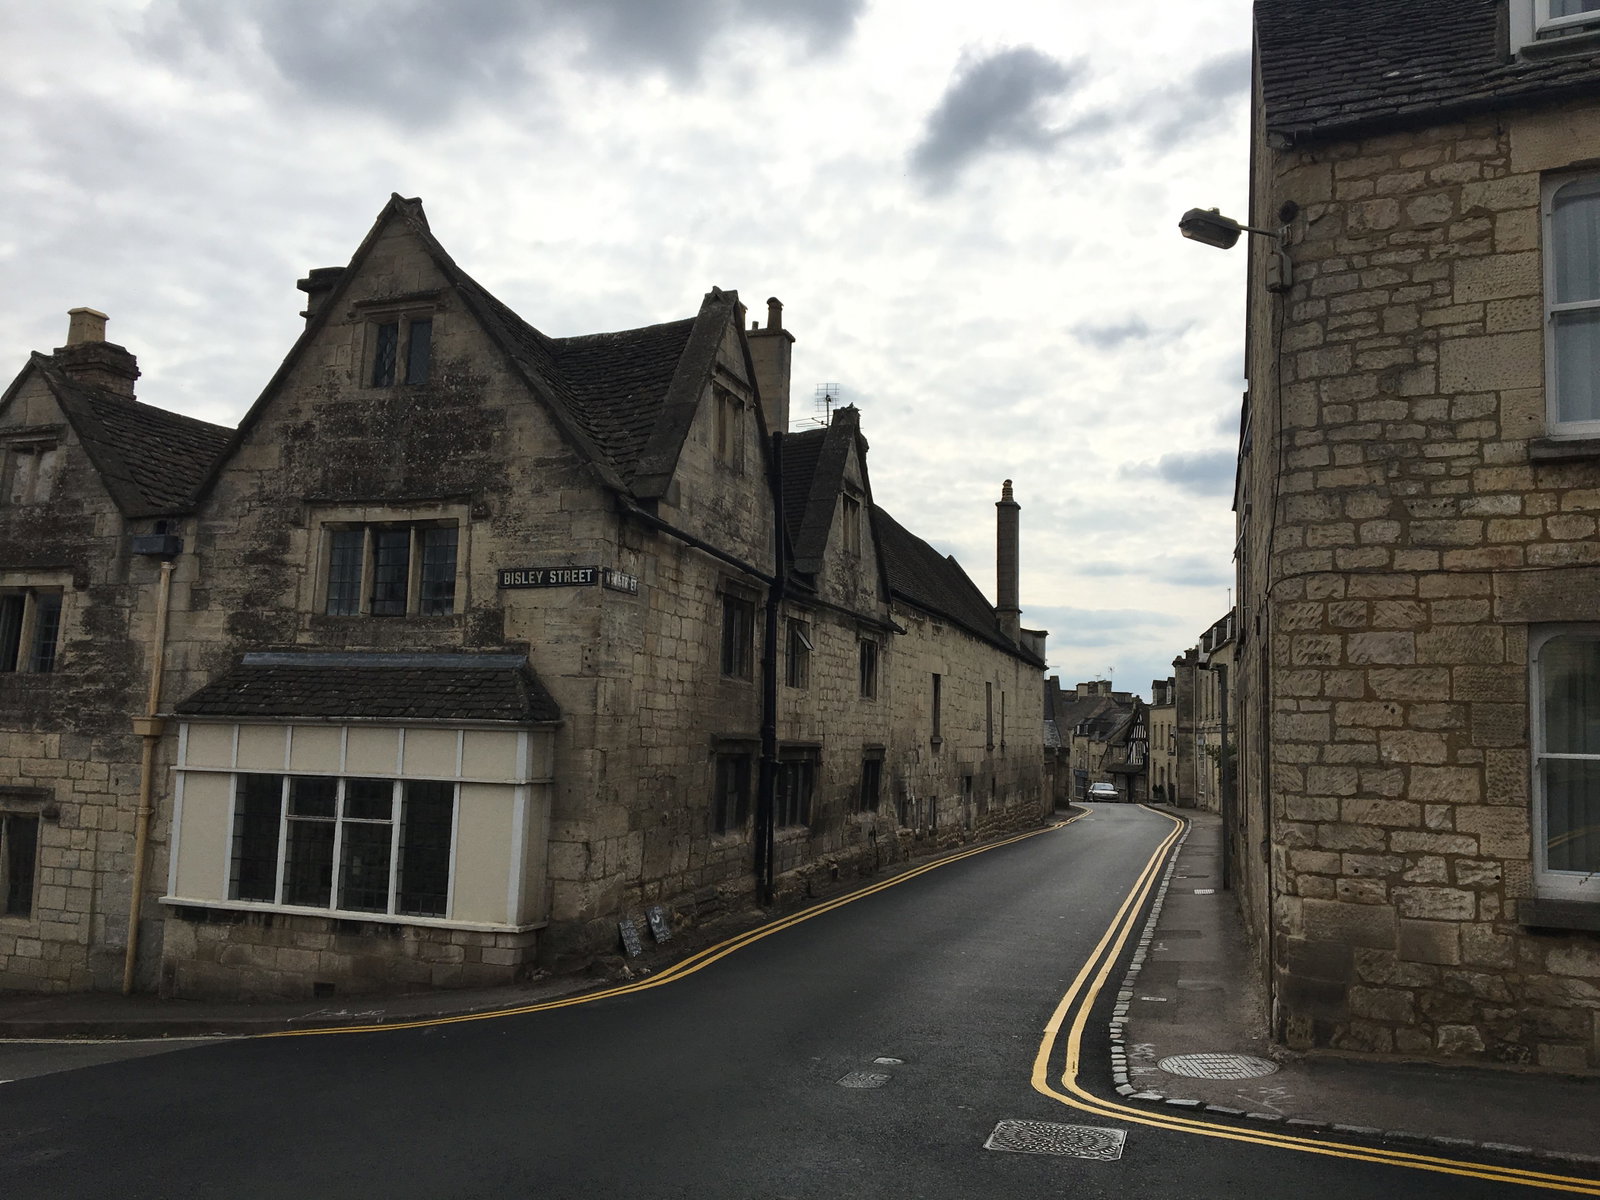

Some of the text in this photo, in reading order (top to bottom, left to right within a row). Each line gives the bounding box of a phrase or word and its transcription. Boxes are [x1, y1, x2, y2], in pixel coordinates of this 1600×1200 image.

[504, 569, 592, 585] BISLEY STREET
[617, 574, 637, 592] STRET
